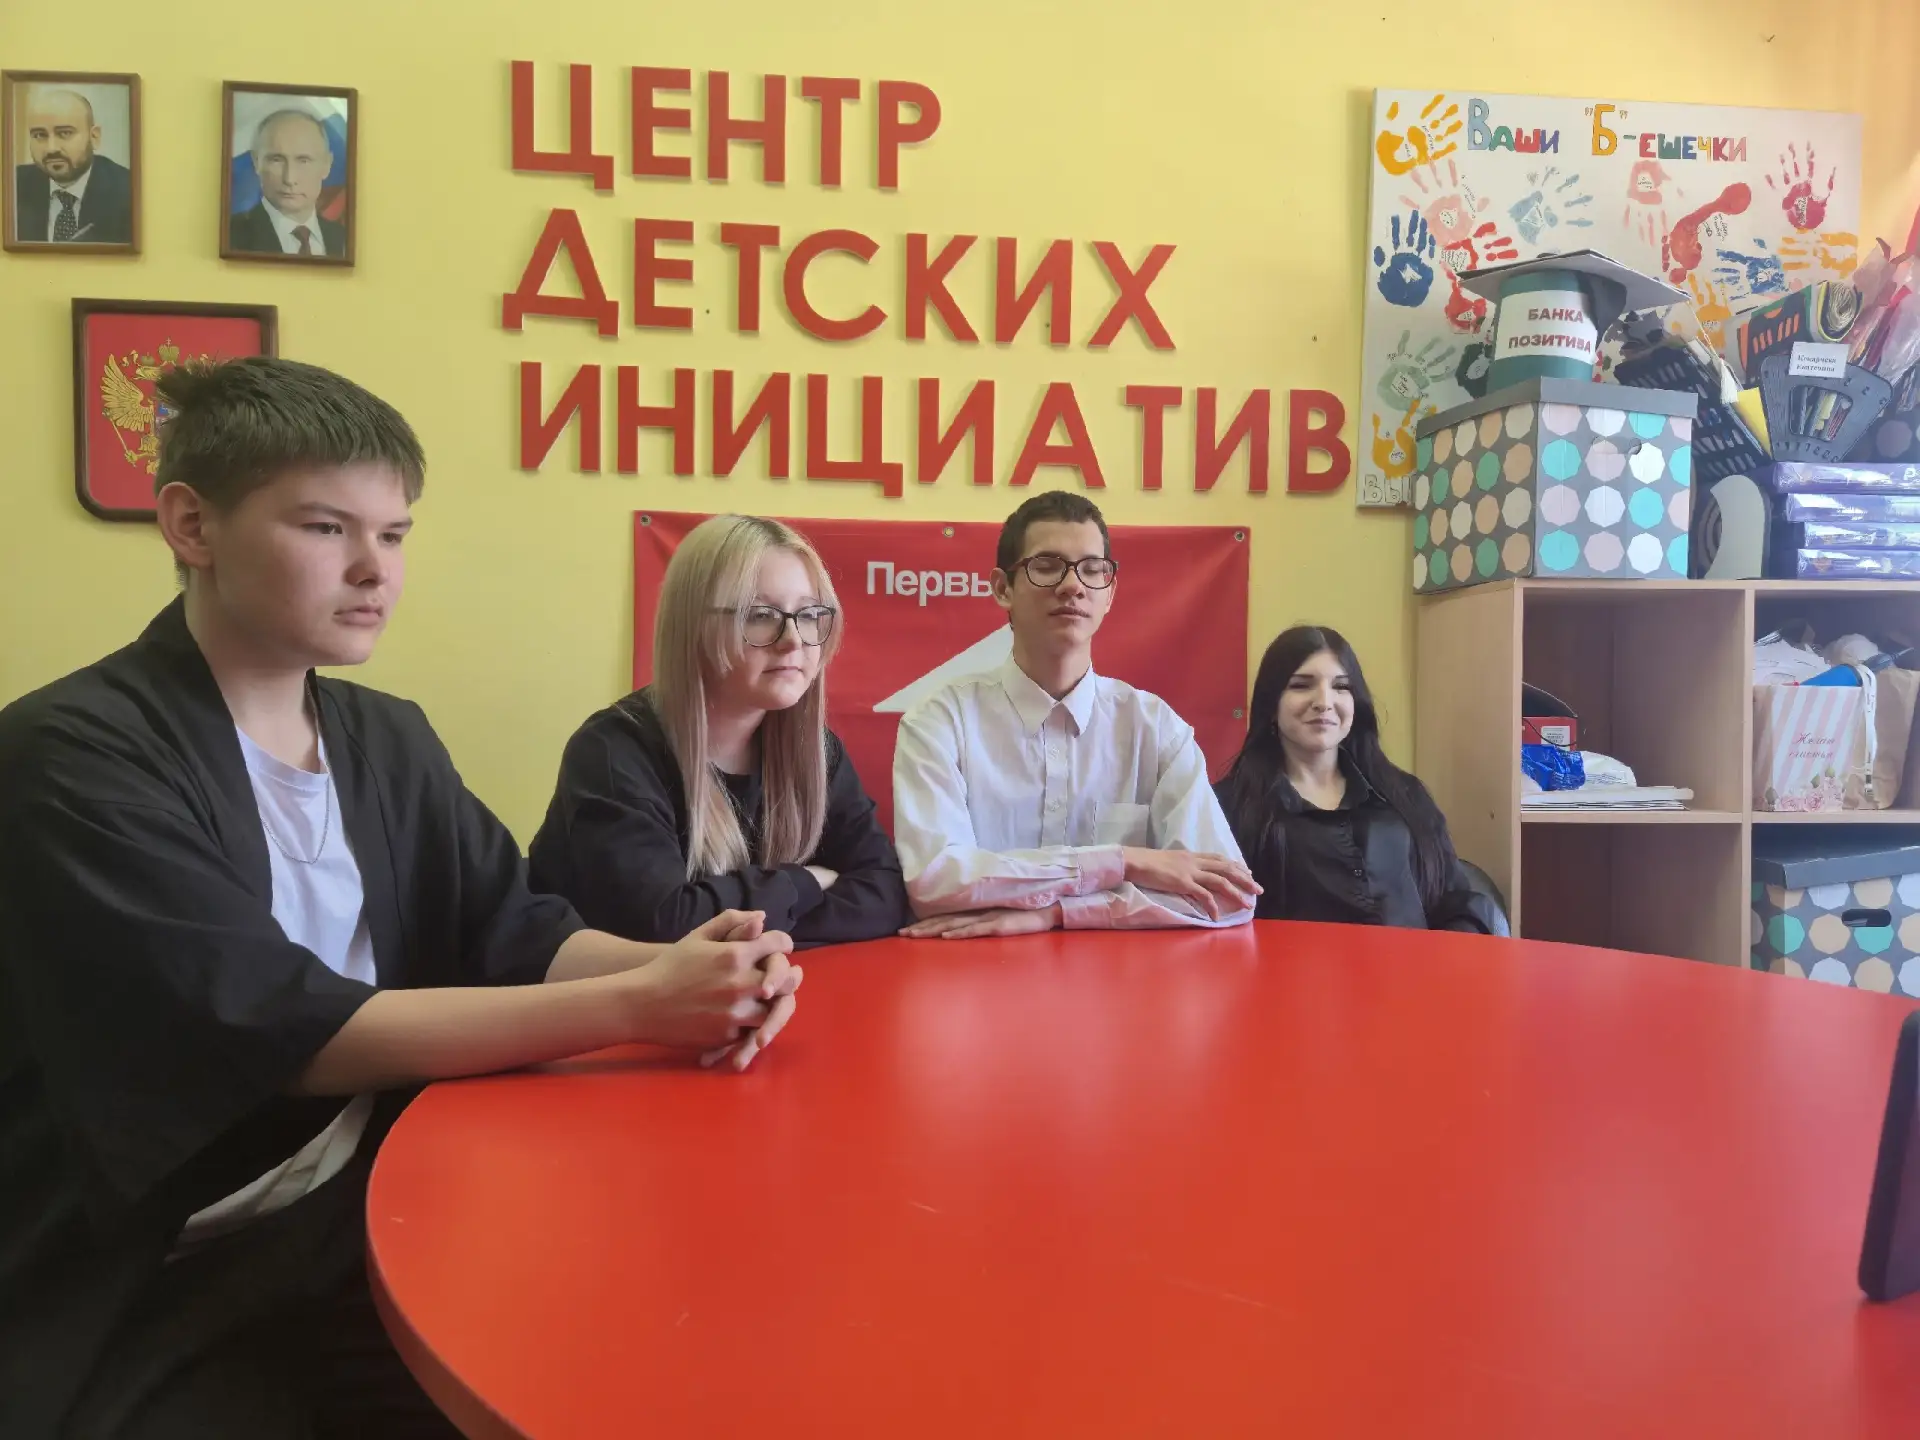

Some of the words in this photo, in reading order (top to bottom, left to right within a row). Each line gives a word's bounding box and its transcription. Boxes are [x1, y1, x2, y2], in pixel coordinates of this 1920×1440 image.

[511, 61, 942, 191] ЦЕНТР
[502, 208, 1177, 350] ДЕТСКИХ
[1508, 334, 1591, 353] ПОЗИТИВА
[1528, 308, 1584, 323] БАНКА
[520, 361, 1351, 498] ИНИЦИАТИВ
